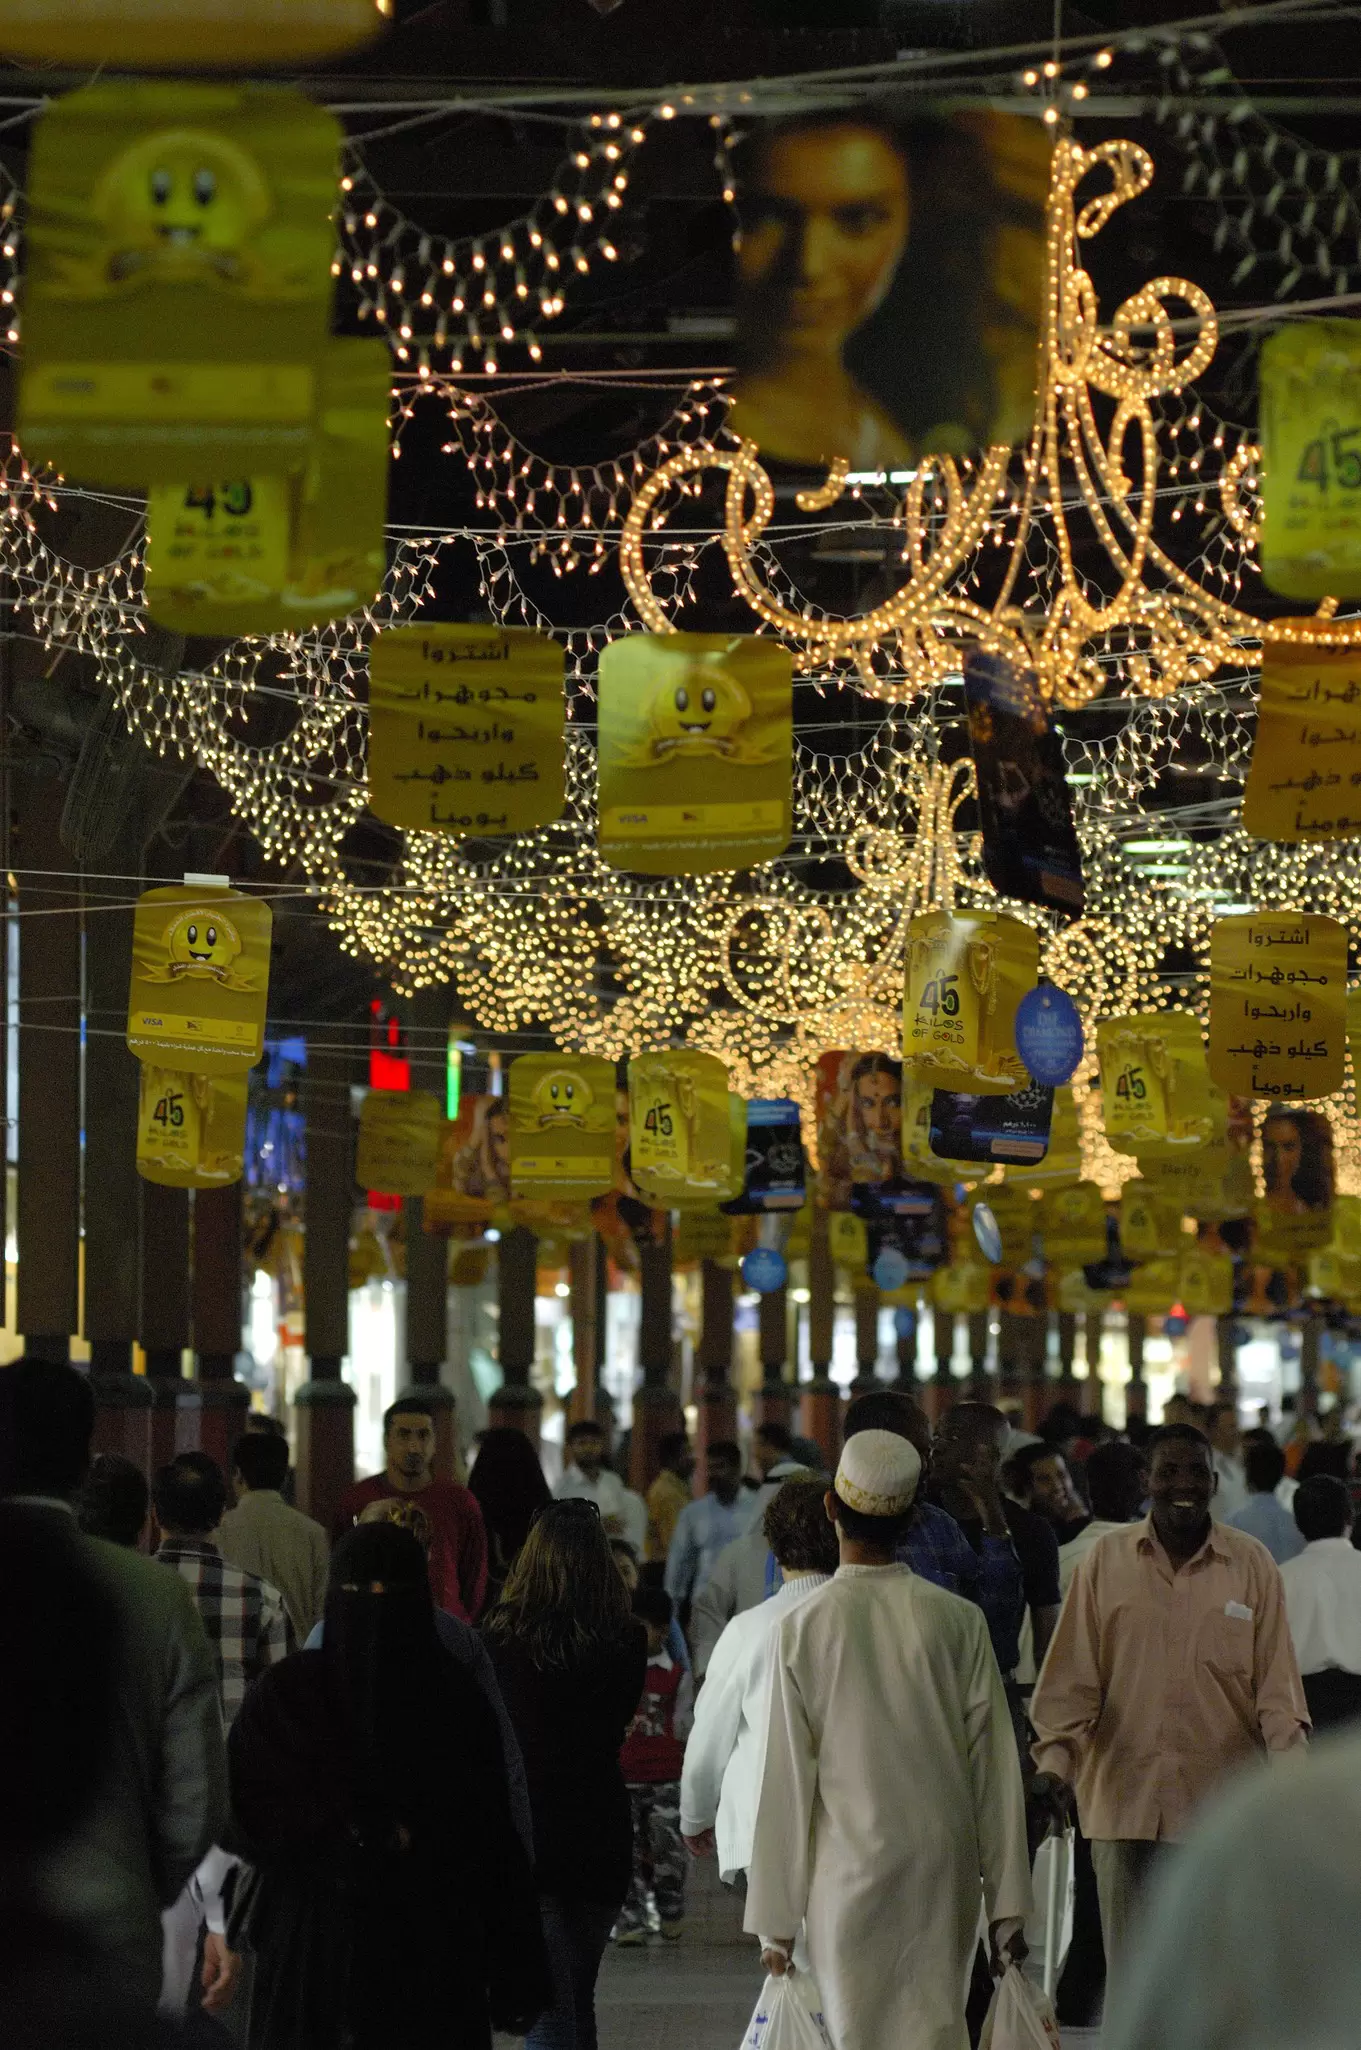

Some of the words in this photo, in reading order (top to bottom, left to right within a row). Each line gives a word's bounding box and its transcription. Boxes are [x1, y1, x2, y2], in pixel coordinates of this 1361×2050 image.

[422, 640, 509, 662] اشتروا
[618, 814, 648, 824] VISA
[1248, 928, 1309, 946] اشتروا
[1228, 964, 1328, 986] مجوهرات
[920, 975, 960, 1016] 45
[142, 1017, 163, 1026] VISA
[914, 1012, 963, 1030] KILOS
[1244, 1000, 1311, 1022] واربحوا
[912, 1028, 928, 1038] OF
[933, 1031, 965, 1045] GOLD
[1226, 1039, 1281, 1059] ذهب
[1287, 1039, 1328, 1060] كيلو
[1116, 1066, 1146, 1101] 45
[1252, 1064, 1305, 1097] يومياً
[153, 1093, 184, 1127] 45
[644, 1103, 673, 1137] 45
